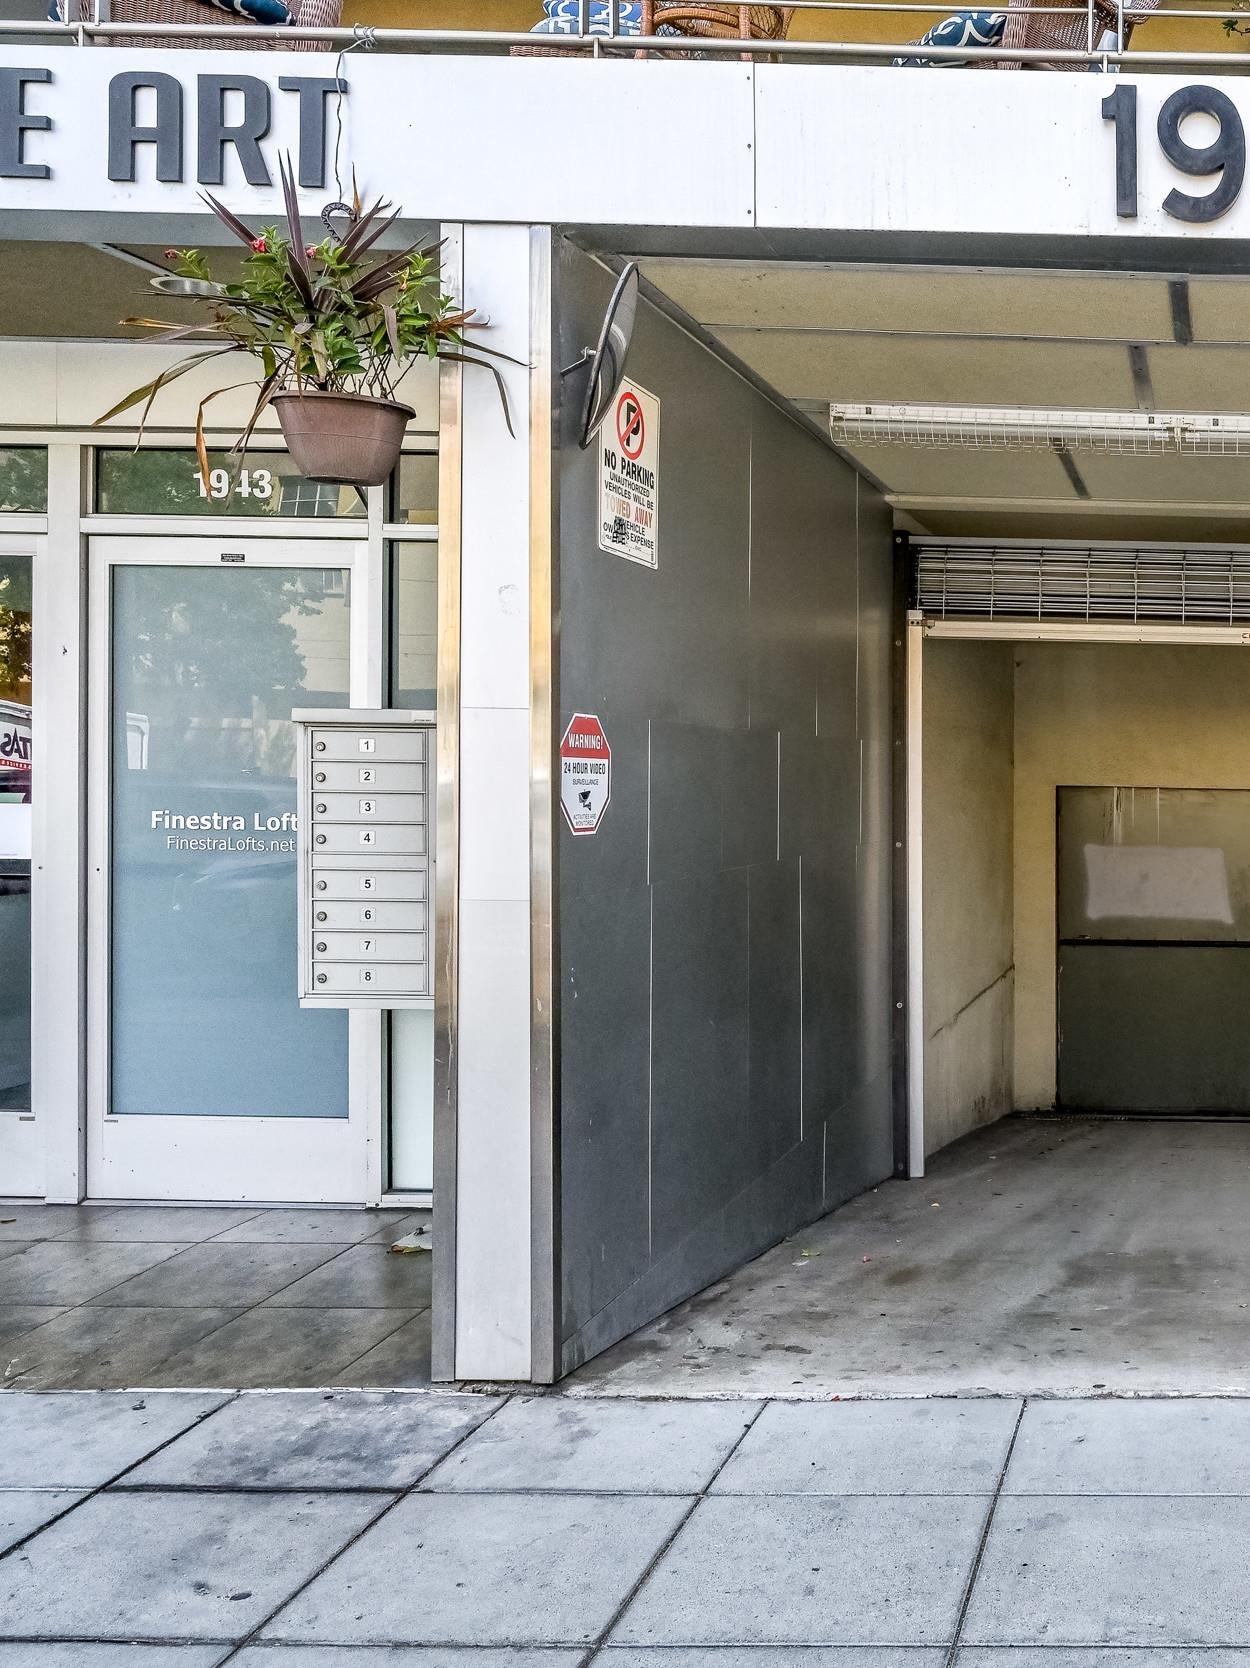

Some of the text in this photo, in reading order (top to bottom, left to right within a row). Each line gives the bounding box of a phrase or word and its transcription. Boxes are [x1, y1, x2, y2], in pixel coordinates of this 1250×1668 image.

[108, 70, 350, 189] ART
[604, 447, 655, 490] NO PARKING
[192, 468, 274, 499] 1943
[609, 471, 650, 498] UNAUTHORIZED
[604, 479, 654, 511] VEHICLES WILL BE
[604, 492, 653, 529] TOWED AWAY
[630, 532, 654, 550] EXPENSE
[363, 740, 370, 751] 1
[568, 732, 604, 750] WARNING!
[363, 771, 371, 781] 2
[563, 761, 606, 775] 24 HOUR VIDEO
[364, 802, 372, 812] 3
[150, 809, 246, 831] Finestra
[166, 834, 297, 852] FinestraLofts.net
[363, 832, 371, 843] 4
[364, 879, 372, 890] 5
[364, 909, 372, 920] 6
[364, 940, 372, 951] 7
[364, 971, 372, 982] 8
